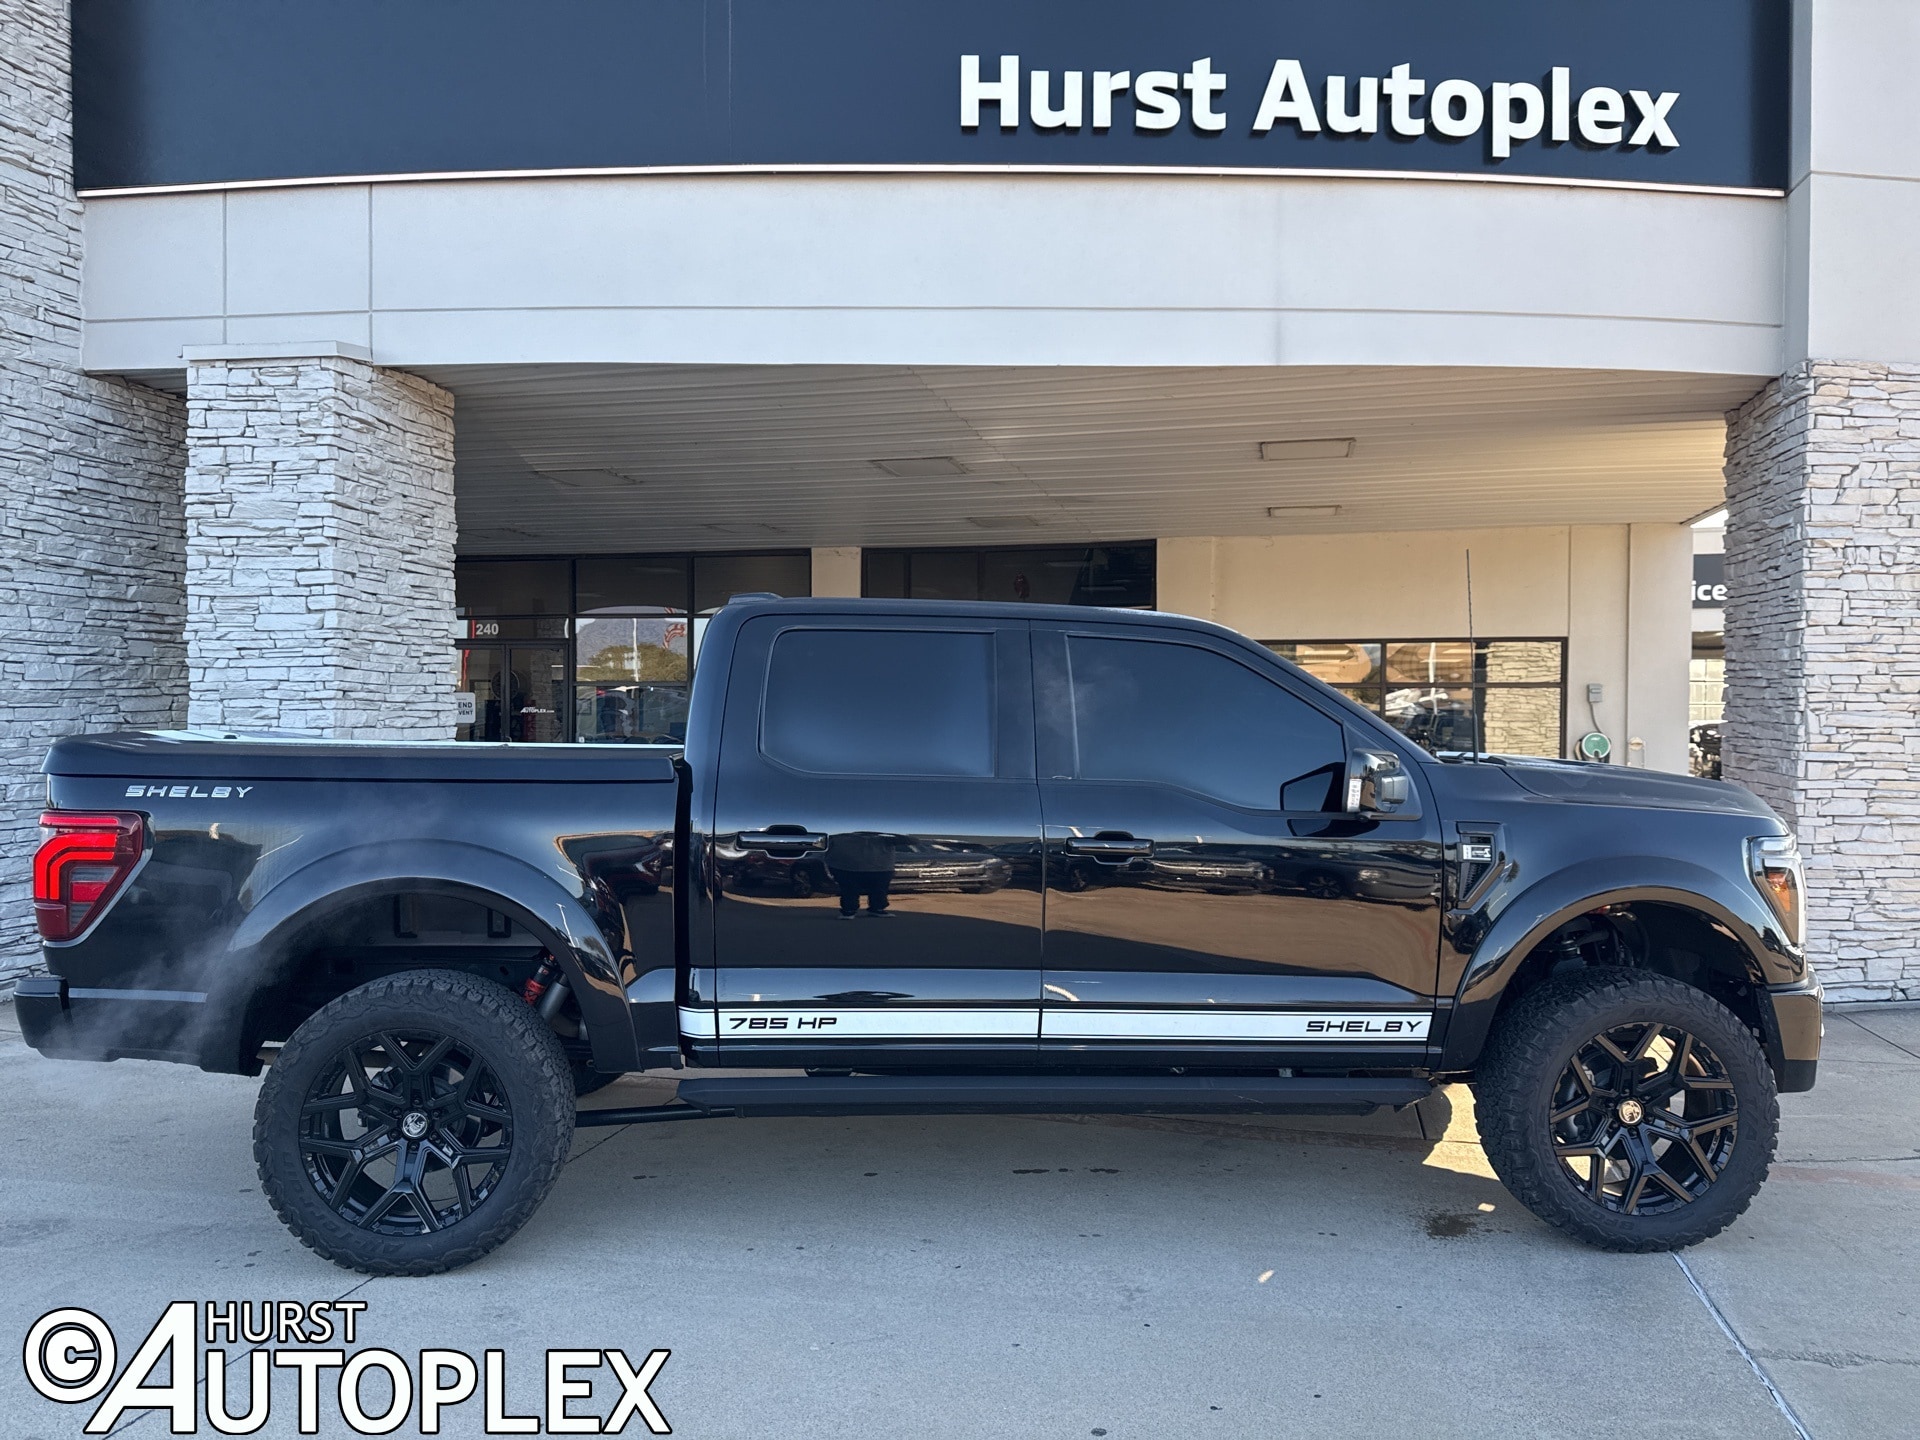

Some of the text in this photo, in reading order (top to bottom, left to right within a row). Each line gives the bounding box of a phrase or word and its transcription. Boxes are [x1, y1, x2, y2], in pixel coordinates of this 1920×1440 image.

[960, 54, 1680, 158] Hurst Autoplex
[476, 624, 499, 635] 240
[125, 785, 253, 798] SHELBY
[729, 1017, 837, 1030] 785 HP
[1306, 1020, 1423, 1032] SHELBY
